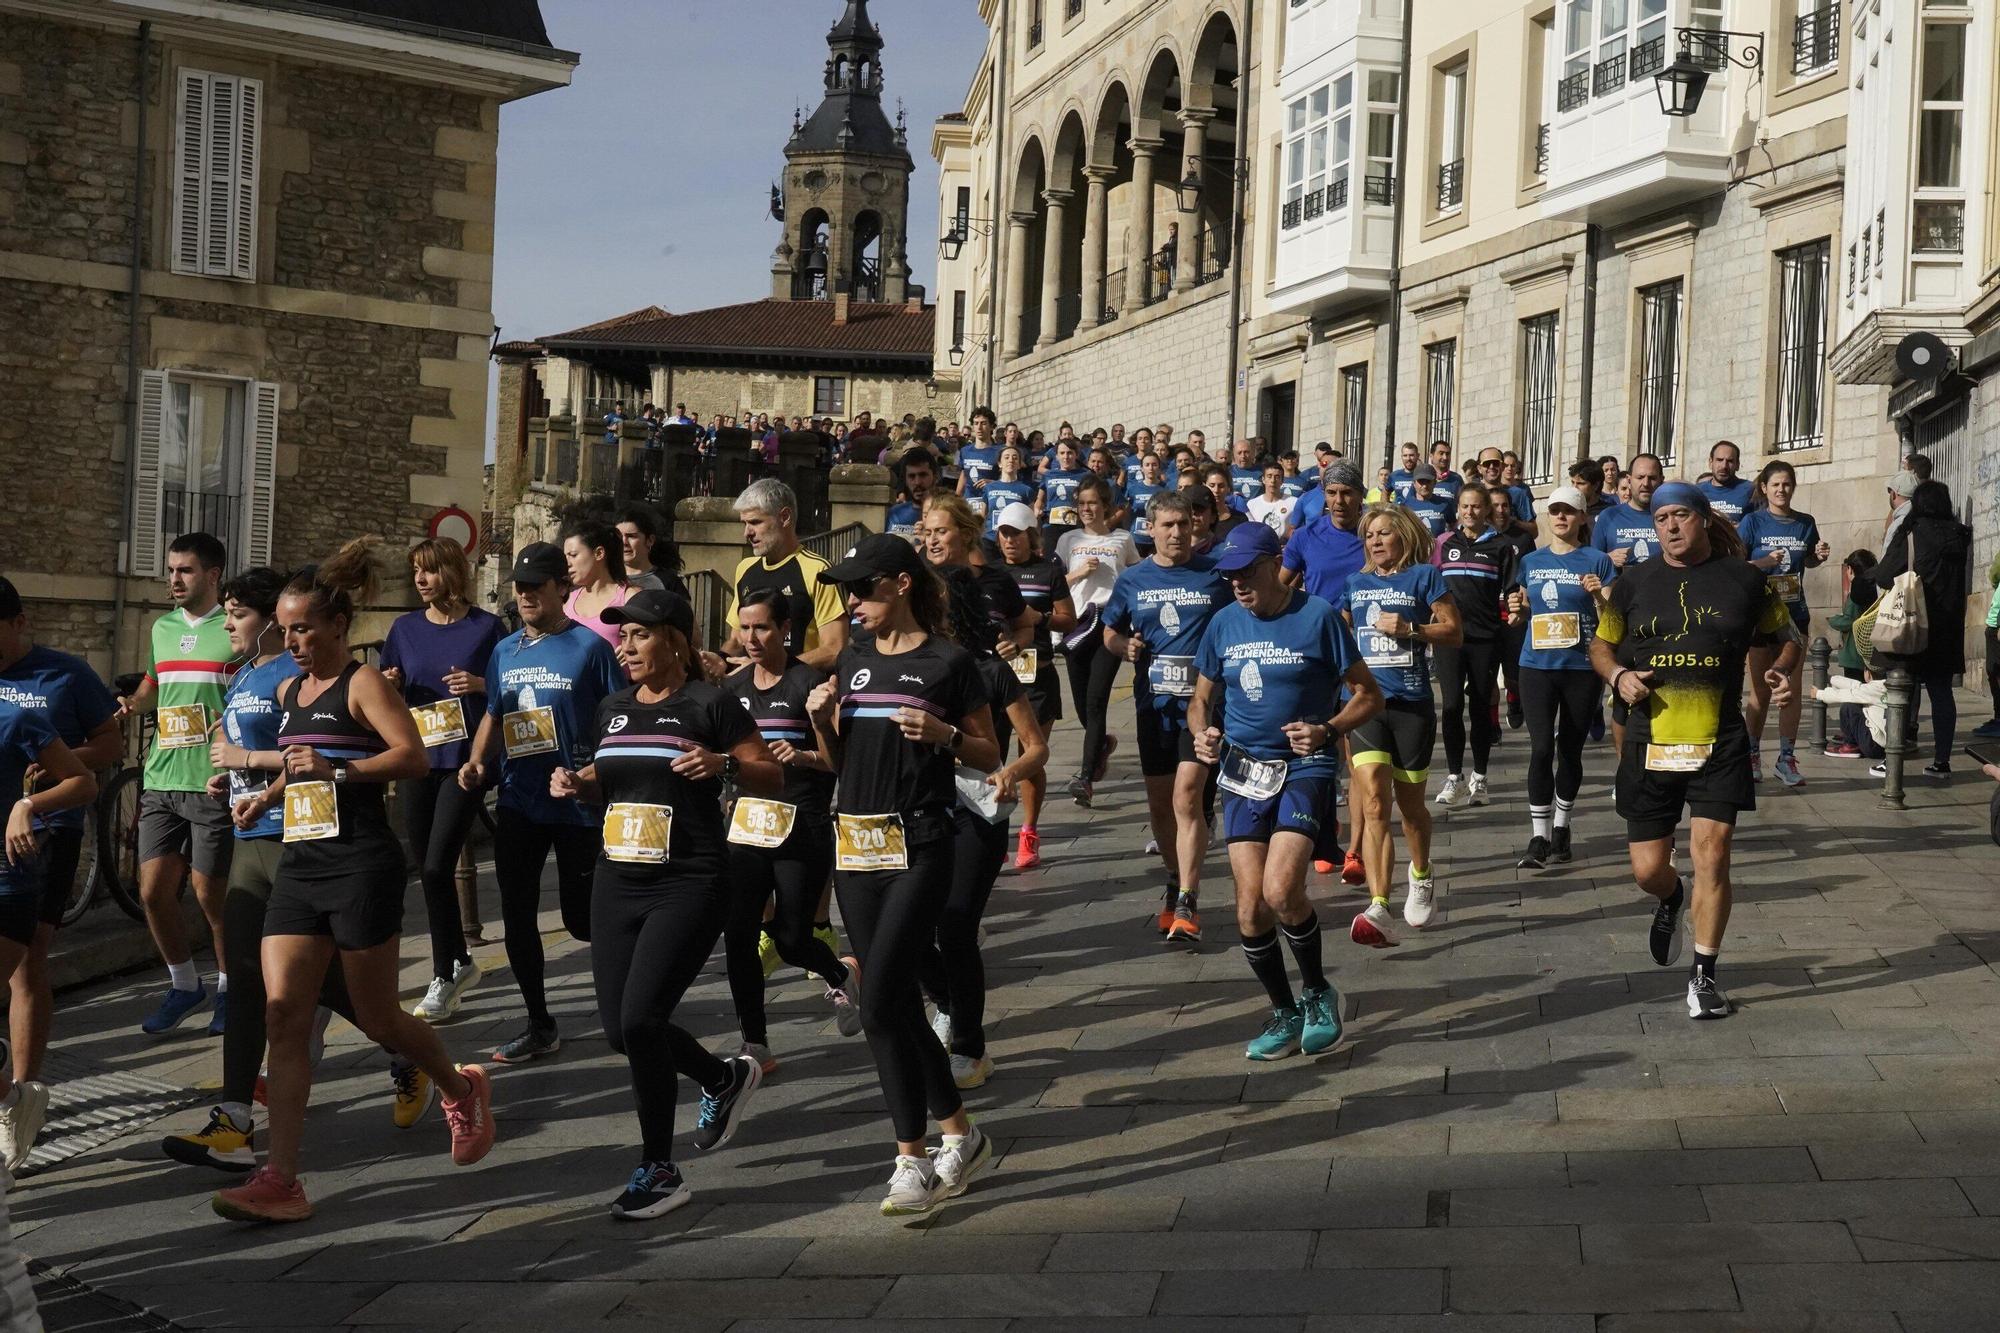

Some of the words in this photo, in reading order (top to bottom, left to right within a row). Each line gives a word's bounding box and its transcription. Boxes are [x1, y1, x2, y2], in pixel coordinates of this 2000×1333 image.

[1144, 587, 1187, 596] CONQUISTA
[1146, 591, 1202, 603] ALMENDRA
[1355, 591, 1407, 601] ALMENDRA
[1176, 598, 1212, 606] KONKISTA
[1380, 598, 1416, 607] KONKISTA
[1548, 621, 1562, 635] 22
[1233, 641, 1275, 651] CONQUISTA
[1370, 636, 1399, 652] 968
[1231, 648, 1291, 660] ALMENDRA
[1260, 656, 1304, 665] KONKISTA
[1649, 654, 1720, 667] 42195.es
[508, 666, 548, 676] CONQUISTA
[1162, 665, 1188, 681] 991
[508, 672, 560, 685] ALMENDRA
[535, 682, 573, 691] KONKISTA
[166, 716, 189, 733] 276
[424, 711, 447, 731] 174
[512, 720, 538, 740] 139
[293, 796, 313, 820] 94
[746, 809, 777, 831] 583
[623, 817, 643, 841] 87
[850, 827, 886, 850] 320
